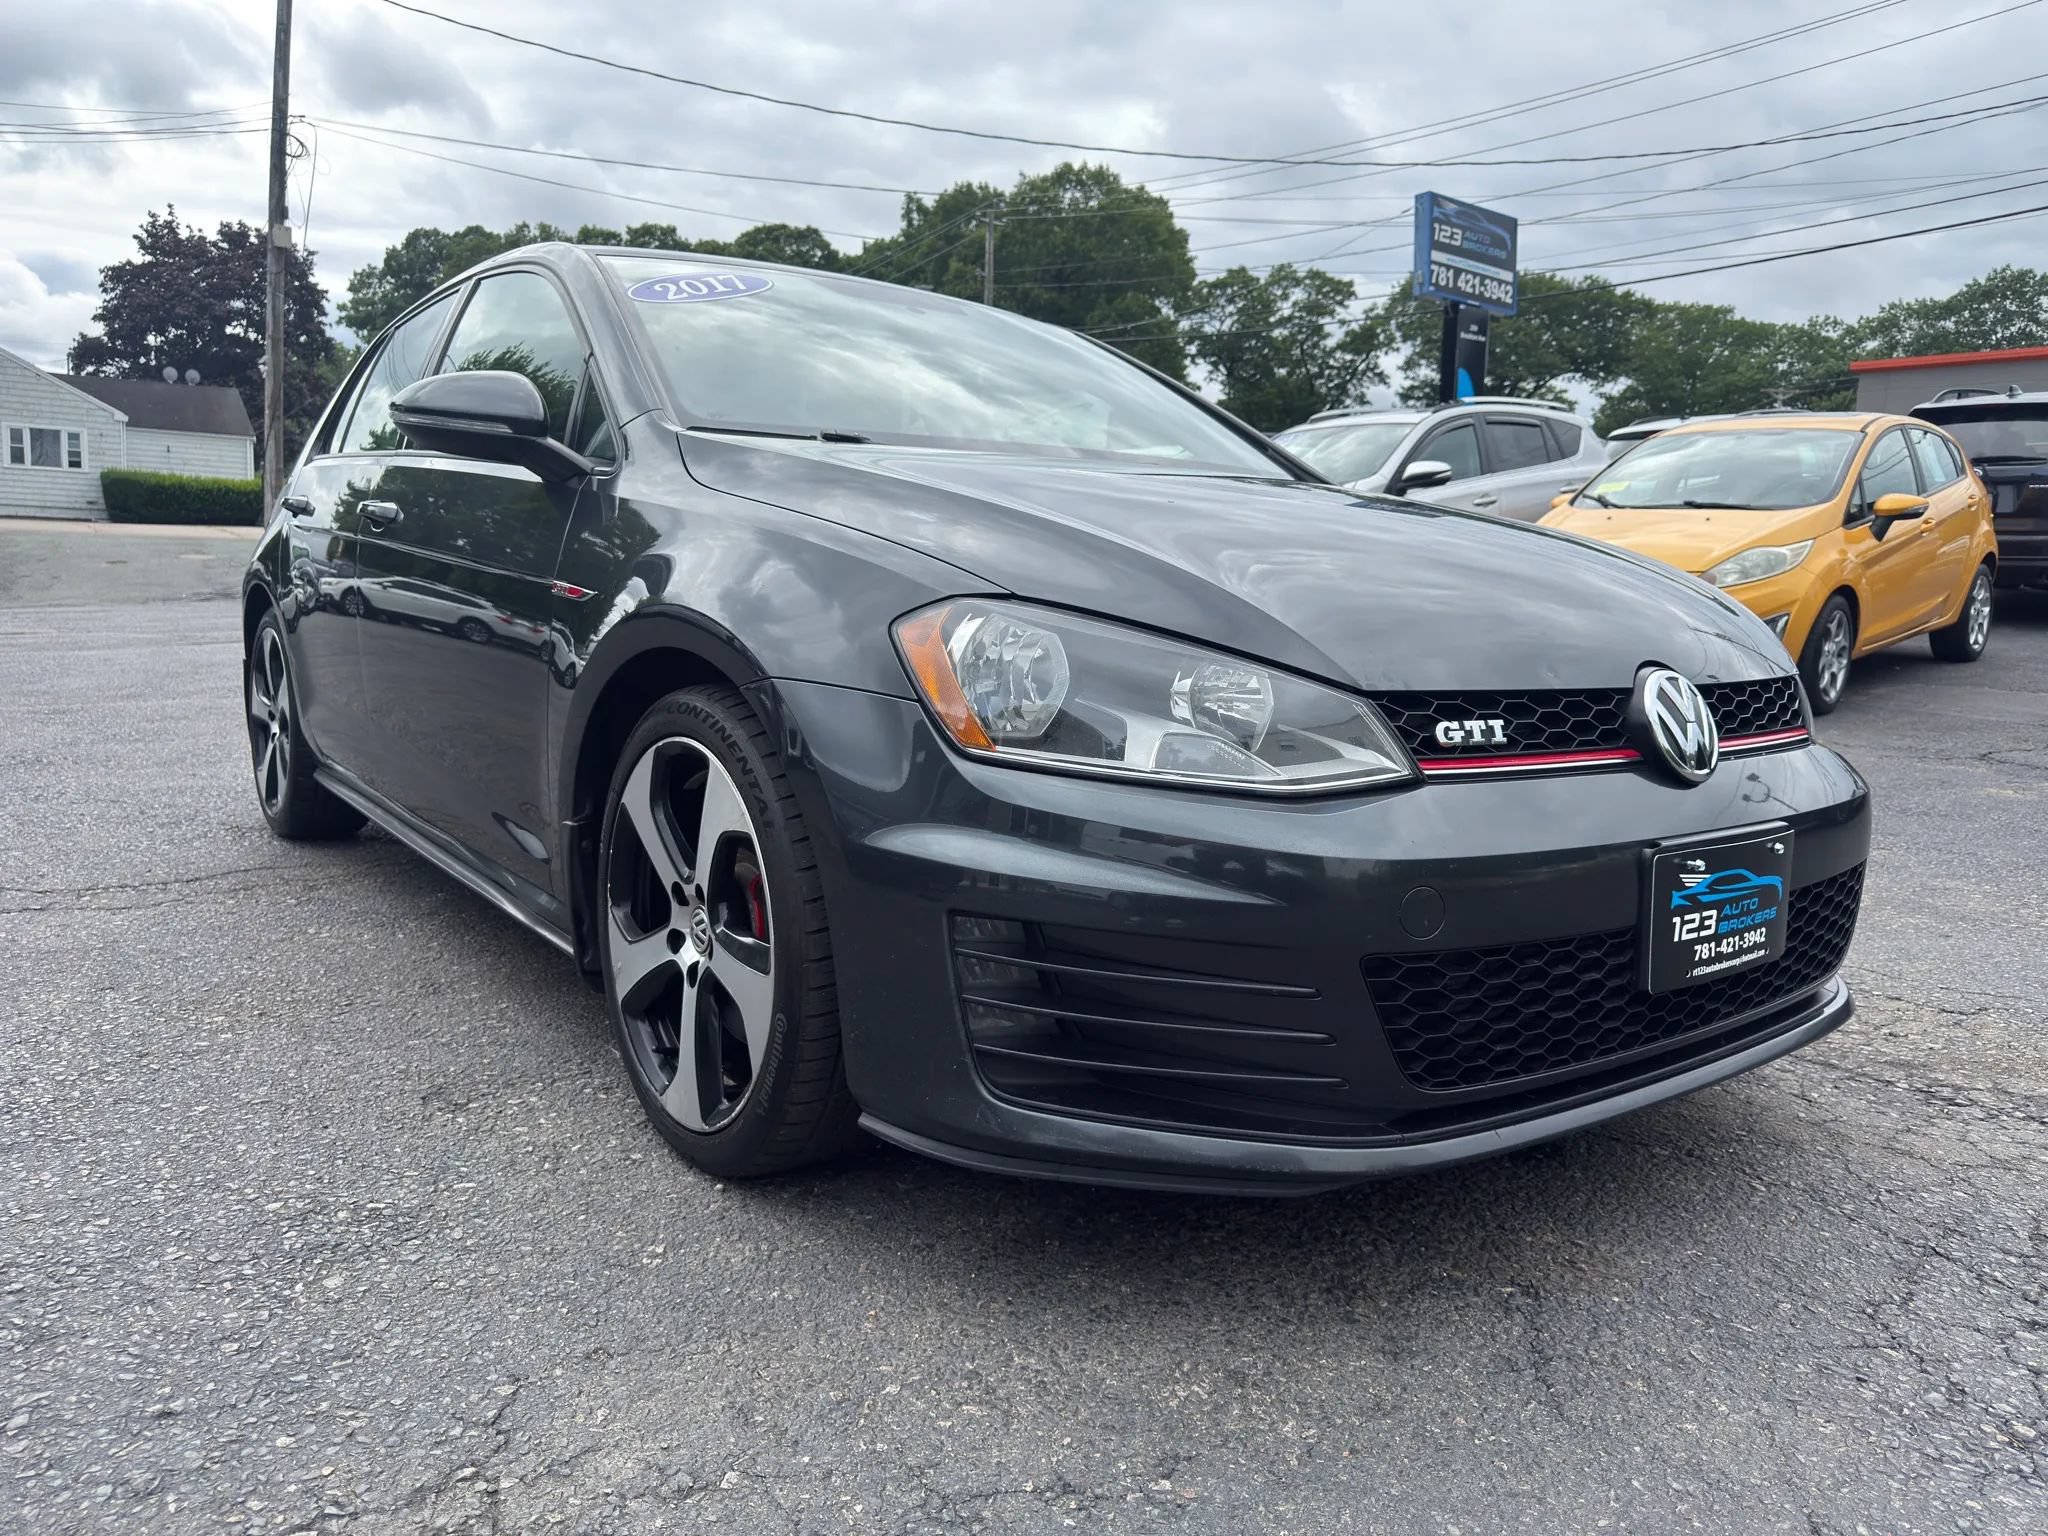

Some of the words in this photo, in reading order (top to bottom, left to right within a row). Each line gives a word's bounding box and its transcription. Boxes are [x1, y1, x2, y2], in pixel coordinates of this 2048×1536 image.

[1433, 222, 1463, 247] 123
[1463, 230, 1491, 244] AUTO
[654, 274, 748, 300] 2017
[1430, 263, 1455, 289] 781
[1435, 719, 1508, 746] GTI
[1672, 909, 1718, 942] 123
[1720, 897, 1759, 918] AUTO
[1717, 906, 1778, 934] BROKERS
[1693, 927, 1767, 961] 781-421-3942
